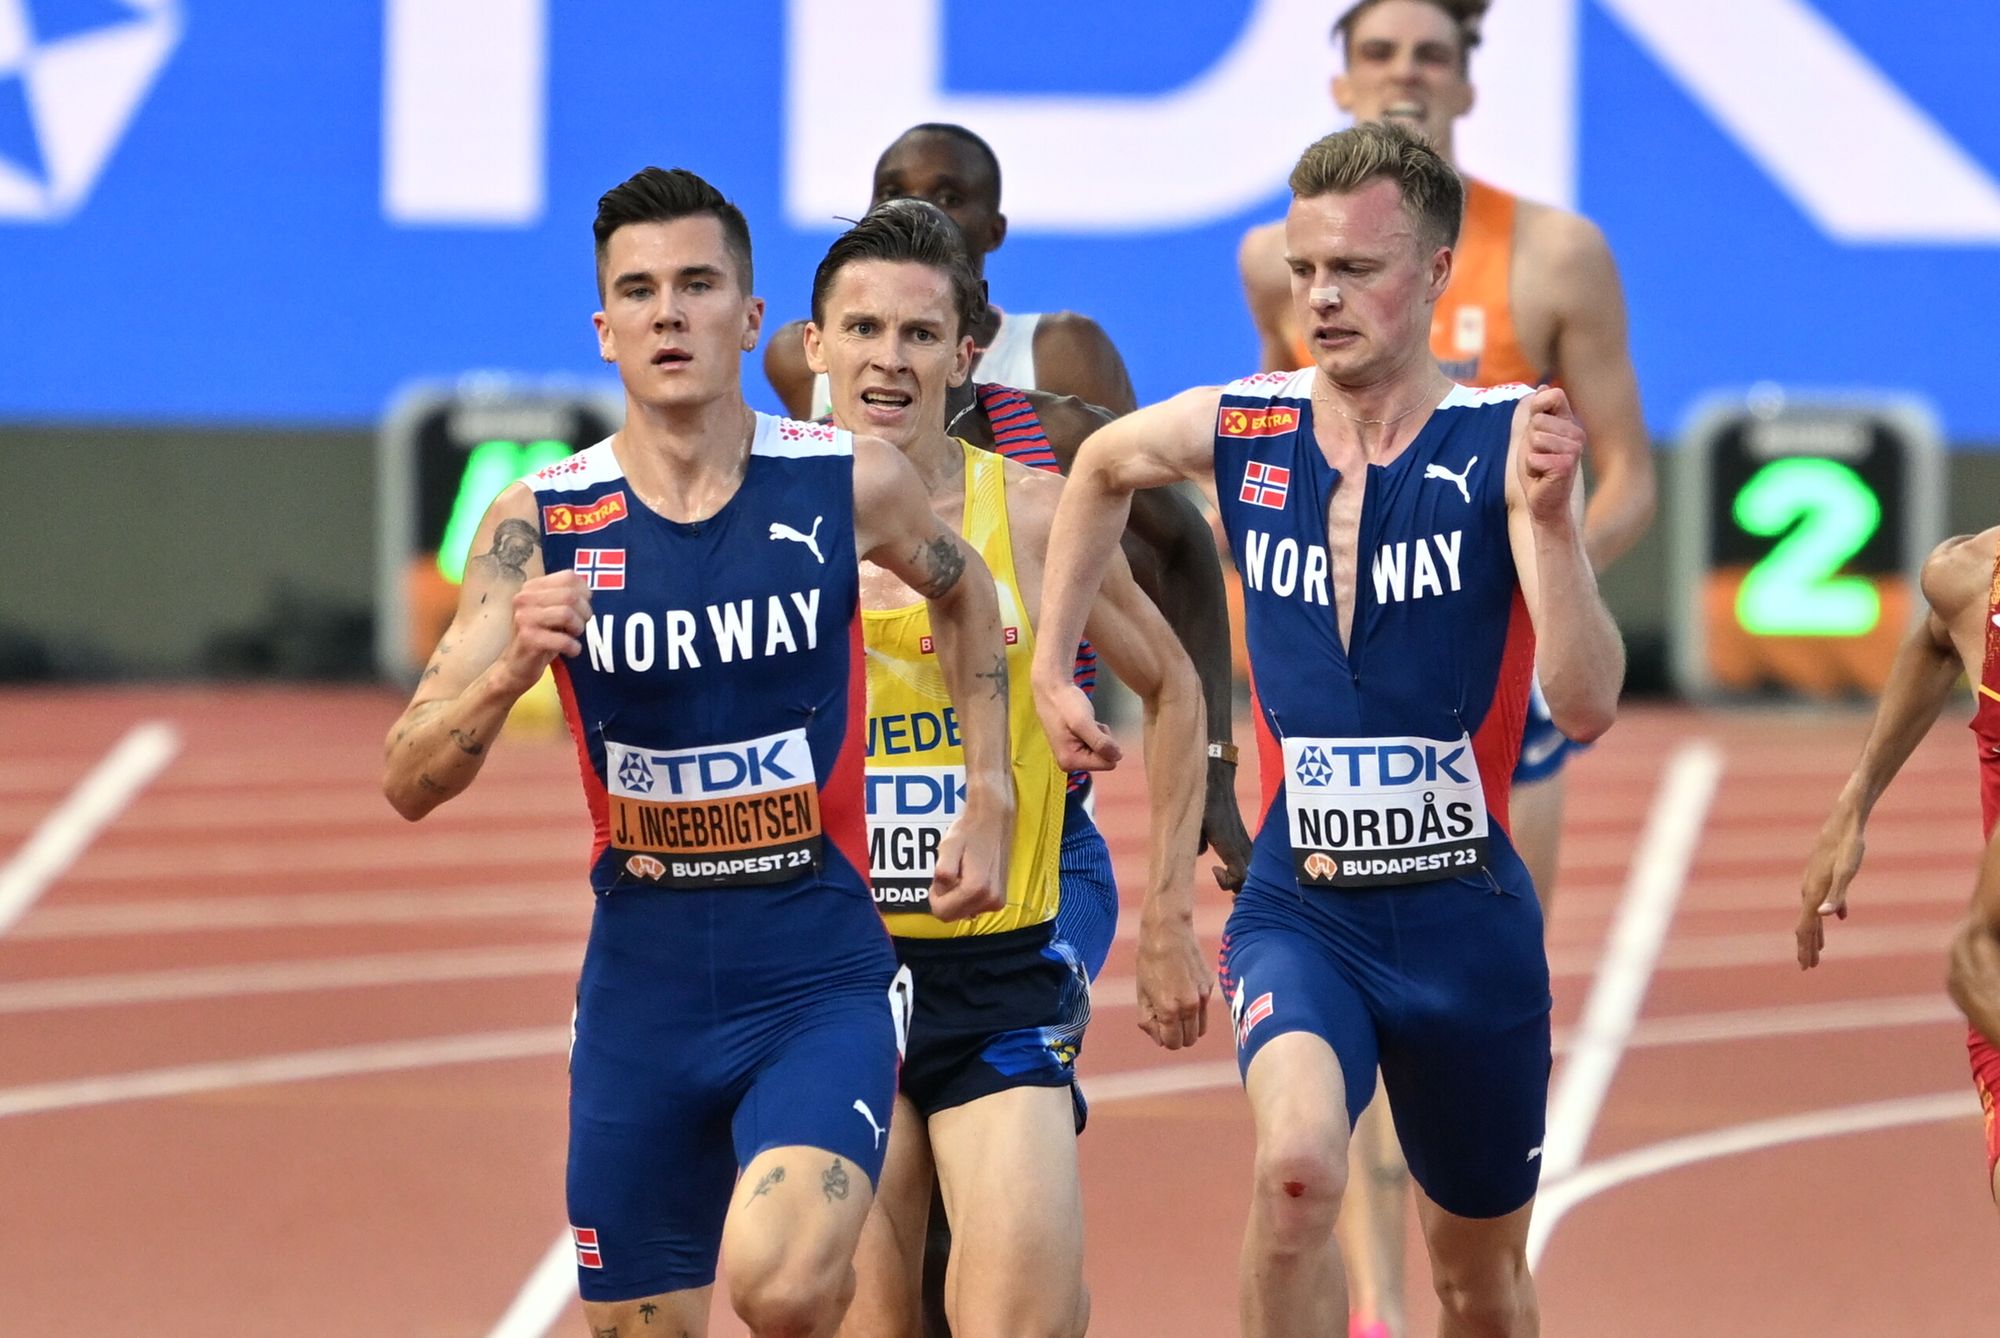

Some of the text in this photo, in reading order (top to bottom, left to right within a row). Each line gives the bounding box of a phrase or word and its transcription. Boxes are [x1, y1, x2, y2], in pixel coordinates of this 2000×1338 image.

[1252, 413, 1293, 430] EXTRA
[574, 501, 621, 526] EXTRA
[1733, 456, 1881, 637] 2
[586, 589, 820, 673] NORWAY
[651, 739, 796, 795] TDK
[1331, 745, 1471, 787] TDK
[617, 790, 812, 848] J. INGEBRIGTSEN
[1298, 791, 1474, 848] NORDÅS
[672, 849, 811, 877] BUDAPEST 23
[1342, 849, 1478, 876] BUDAPEST 23
